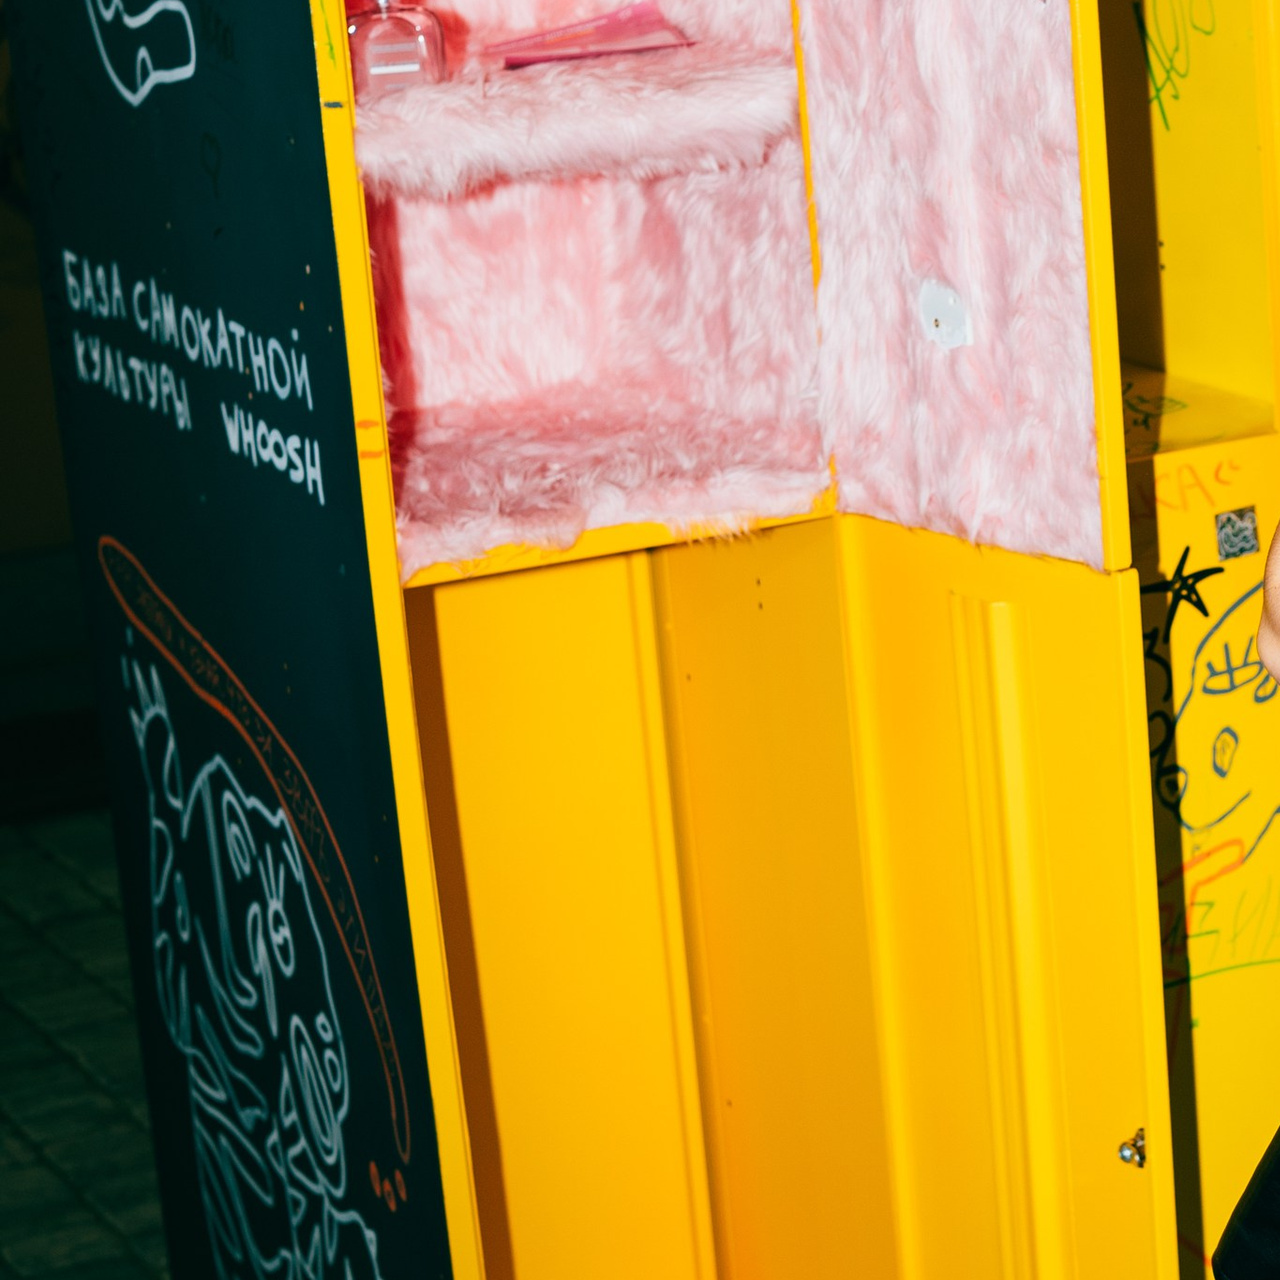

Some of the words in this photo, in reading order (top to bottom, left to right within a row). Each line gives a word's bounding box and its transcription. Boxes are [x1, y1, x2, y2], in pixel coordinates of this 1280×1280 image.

[63, 249, 126, 318] БАЗА
[133, 276, 314, 412] САМОКАТНОЙ
[73, 329, 192, 431] КУЛЬТУРЫ
[220, 401, 326, 507] WHOOSH
